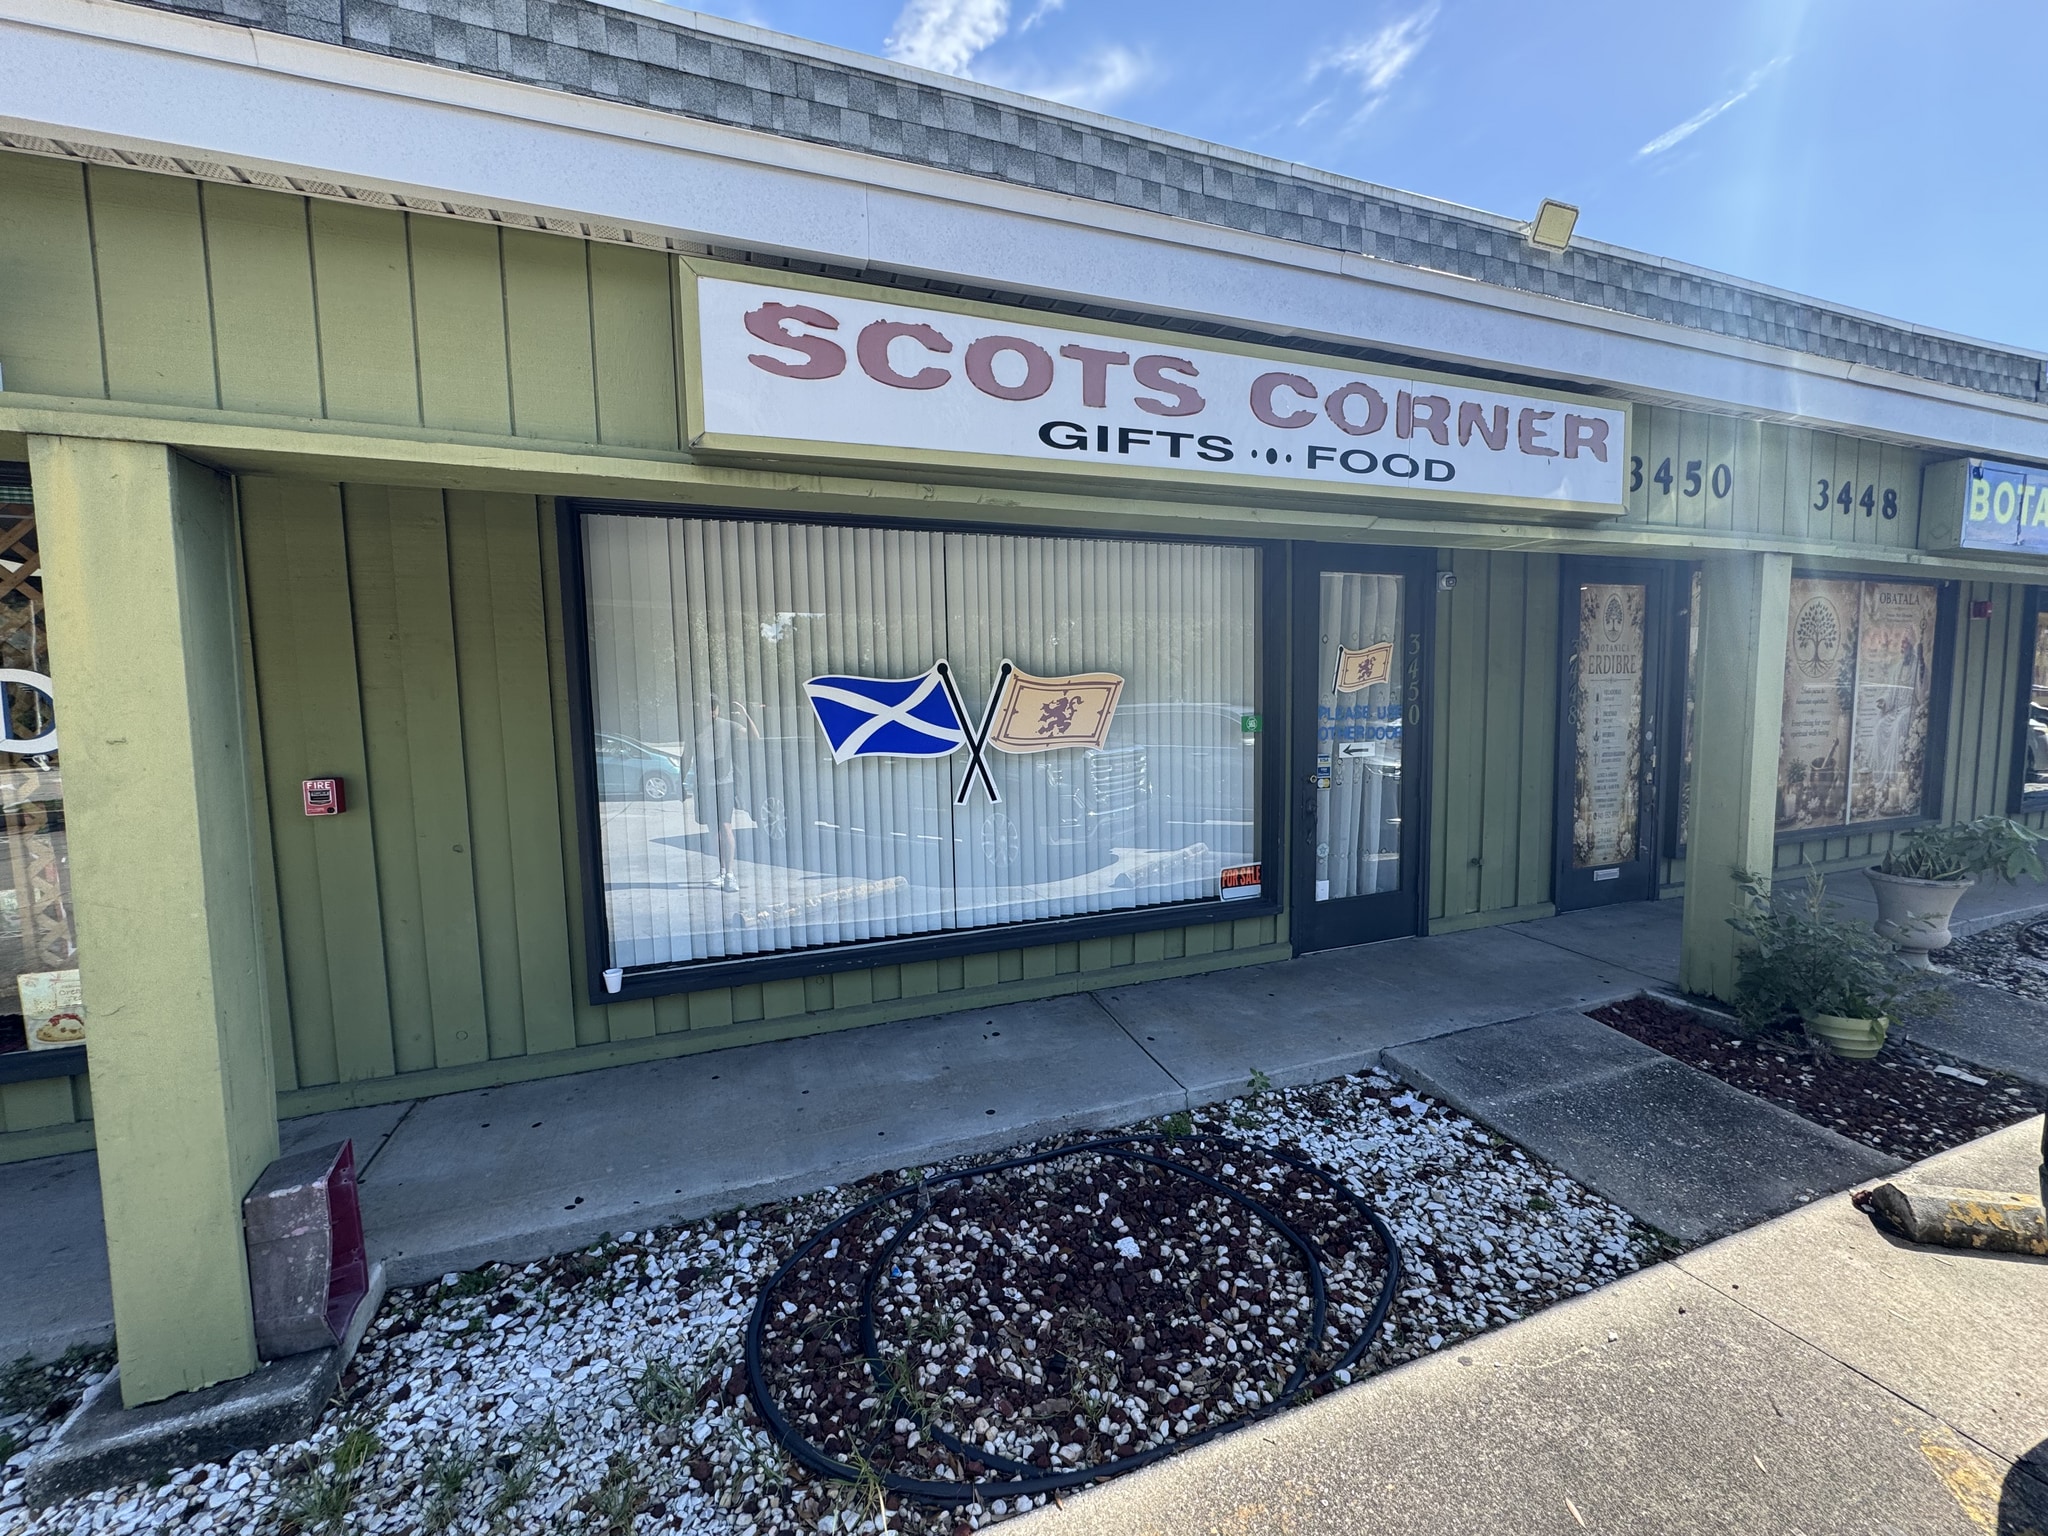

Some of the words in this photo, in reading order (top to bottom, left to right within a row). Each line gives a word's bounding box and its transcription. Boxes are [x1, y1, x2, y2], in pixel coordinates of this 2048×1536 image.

[744, 301, 1206, 417] SCOTS
[1249, 371, 1610, 463] CORNER
[1038, 420, 1235, 462] GIFTS
[1307, 445, 1456, 483] FOOD
[1630, 455, 1732, 499] 3450
[1813, 479, 1898, 520] 3448
[1408, 633, 1420, 726] 3450
[1588, 654, 1637, 675] ERDIBRE
[1318, 705, 1370, 721] PLEASE
[1377, 704, 1402, 720] USE
[1318, 726, 1365, 740] OTHER
[306, 781, 331, 789] FIRE
[1222, 869, 1238, 888] FOR
[1240, 865, 1261, 885] SALE
